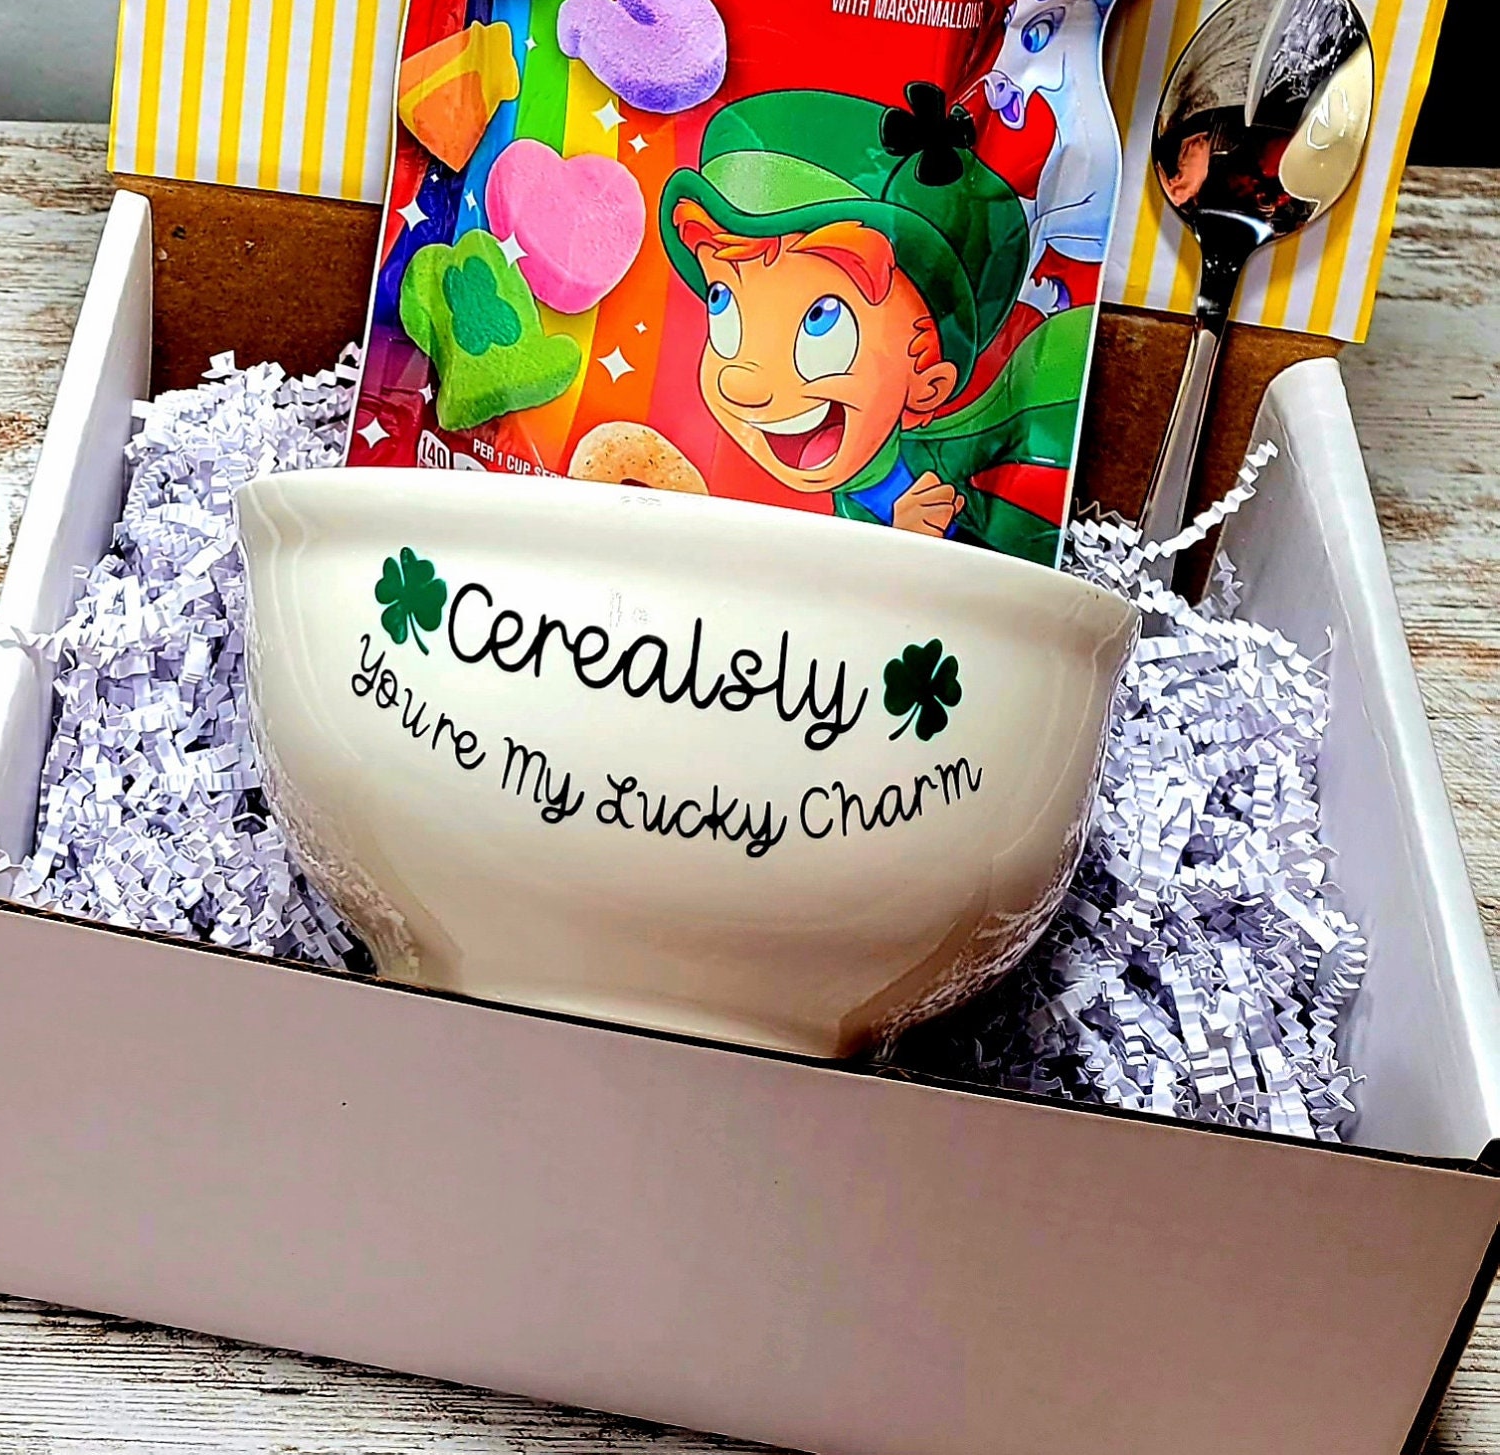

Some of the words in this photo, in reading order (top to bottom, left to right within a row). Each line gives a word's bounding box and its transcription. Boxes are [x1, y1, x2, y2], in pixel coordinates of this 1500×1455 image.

[422, 436, 446, 469] 140
[473, 438, 495, 462] PER
[497, 452, 503, 466] 1
[506, 455, 531, 476] CUP
[447, 582, 869, 751] Cerealsly
[596, 773, 787, 858] Lucky
[799, 756, 983, 841] Charm
